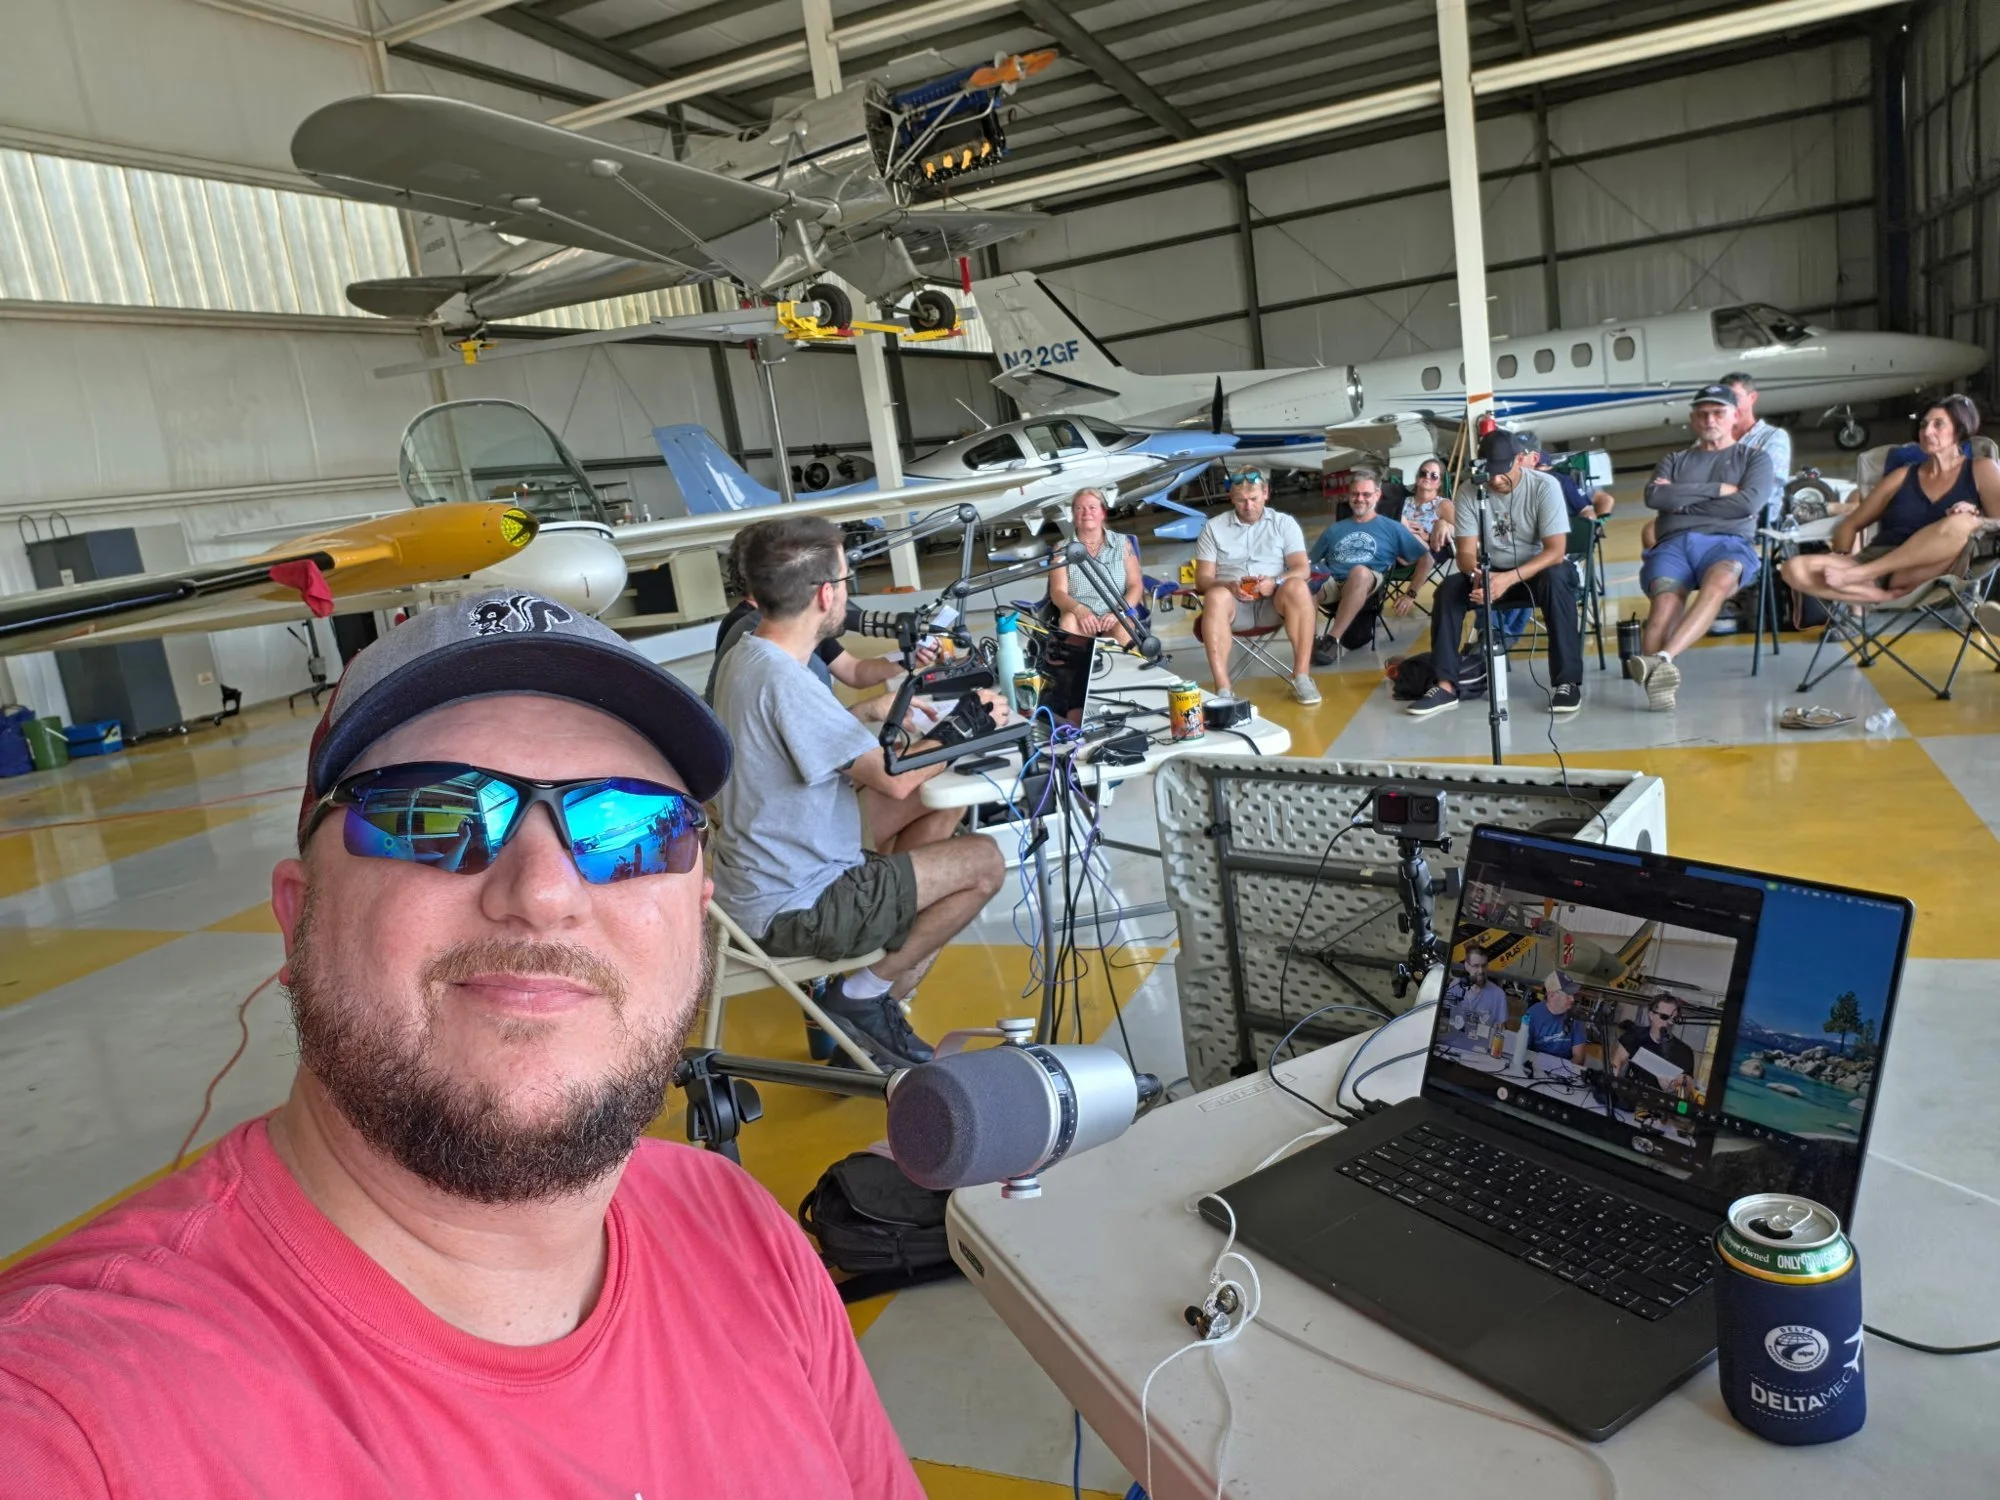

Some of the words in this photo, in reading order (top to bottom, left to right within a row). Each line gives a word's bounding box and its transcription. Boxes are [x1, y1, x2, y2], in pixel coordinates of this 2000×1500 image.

[1003, 340, 1080, 369] N22GF
[1740, 1246, 1770, 1263] Owned
[1777, 1254, 1801, 1270] ONLY
[1779, 1326, 1814, 1335] DELTA
